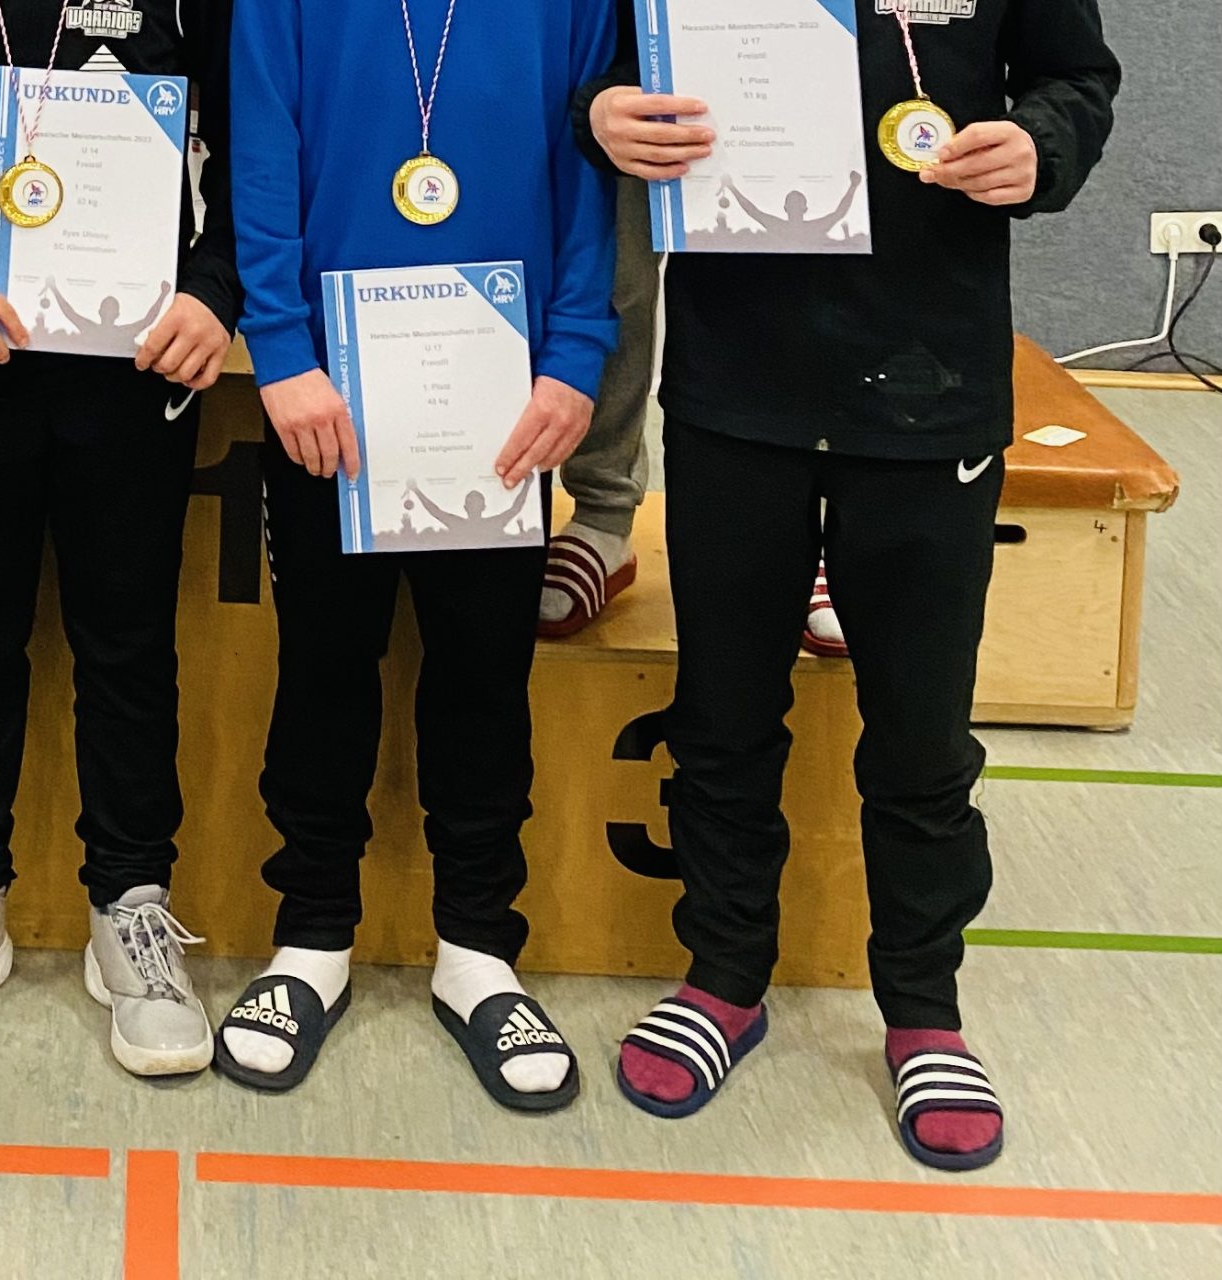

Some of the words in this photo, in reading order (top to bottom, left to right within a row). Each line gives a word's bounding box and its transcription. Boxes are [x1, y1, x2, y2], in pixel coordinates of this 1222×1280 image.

[68, 9, 141, 32] WARRIORS
[23, 83, 131, 105] URKUNDE
[154, 104, 176, 116] HRV
[357, 282, 469, 303] URKUNDE
[492, 293, 515, 304] HRV
[1094, 519, 1107, 534] 4
[230, 1005, 299, 1037] adidas
[496, 1027, 565, 1052] adidas
